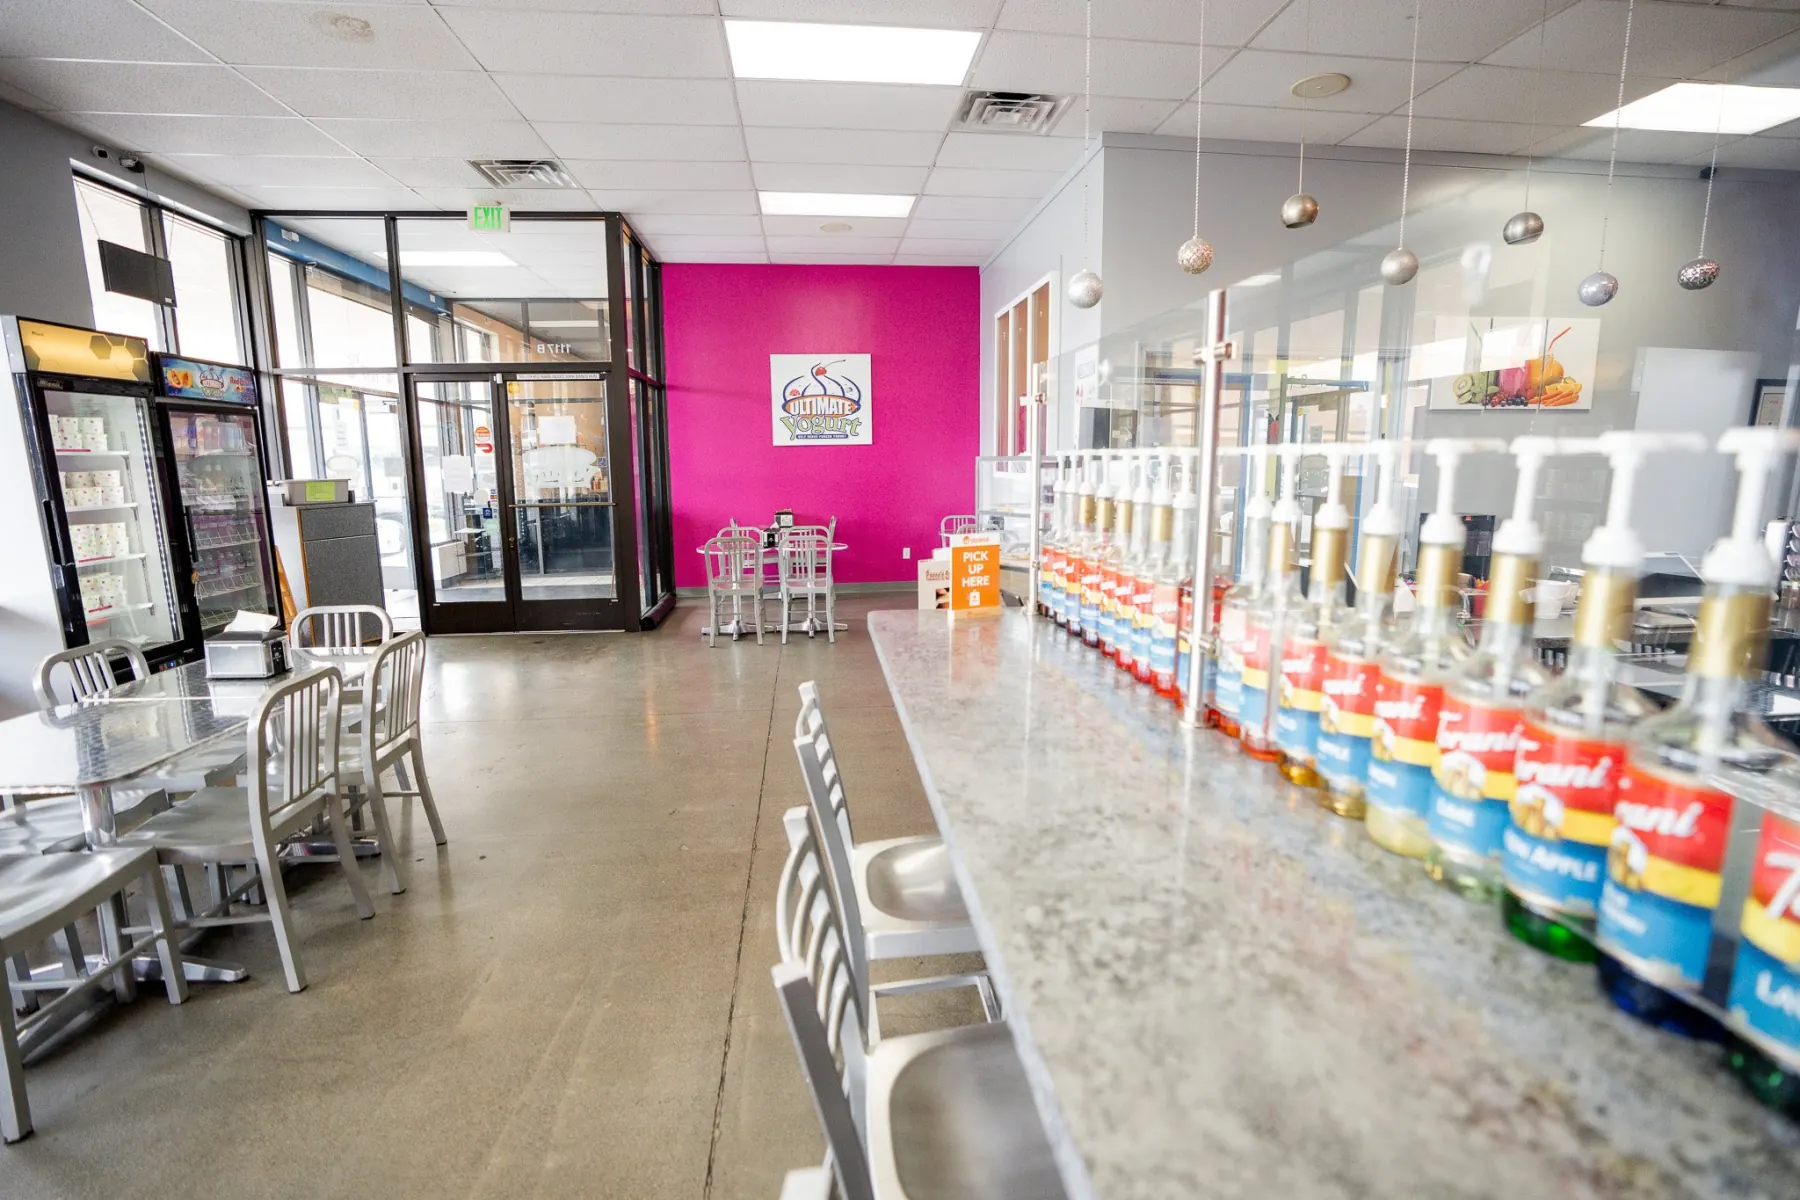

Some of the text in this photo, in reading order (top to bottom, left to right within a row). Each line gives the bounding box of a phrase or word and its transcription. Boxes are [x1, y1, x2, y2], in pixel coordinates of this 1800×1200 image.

[474, 206, 503, 230] EXIT
[790, 397, 853, 415] ULTIMATE
[780, 415, 862, 441] Yogurt
[963, 551, 989, 562] PICK
[968, 564, 984, 574] UP
[962, 575, 990, 588] HERE
